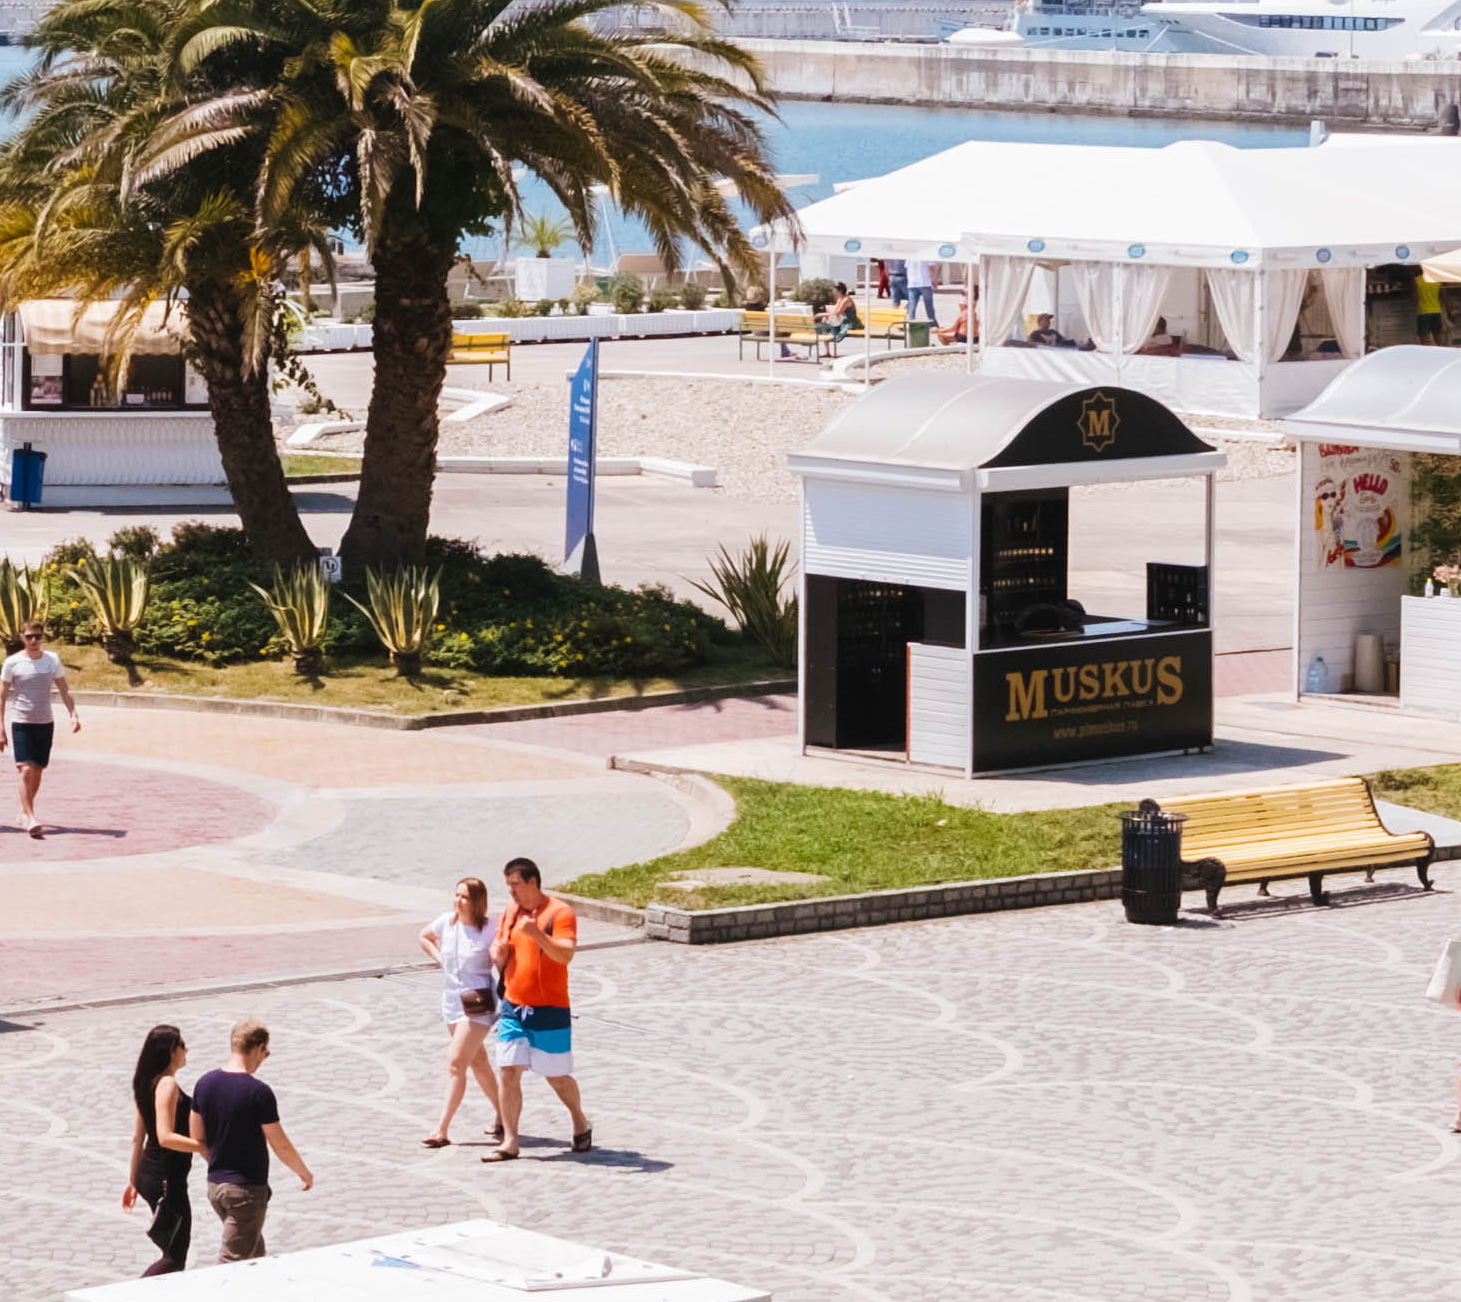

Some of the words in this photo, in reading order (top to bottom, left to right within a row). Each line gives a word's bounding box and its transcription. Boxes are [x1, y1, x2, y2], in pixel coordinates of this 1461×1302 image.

[1087, 409, 1110, 437] M
[1353, 473, 1389, 496] HELLO
[1005, 655, 1184, 722] MUSKUS
